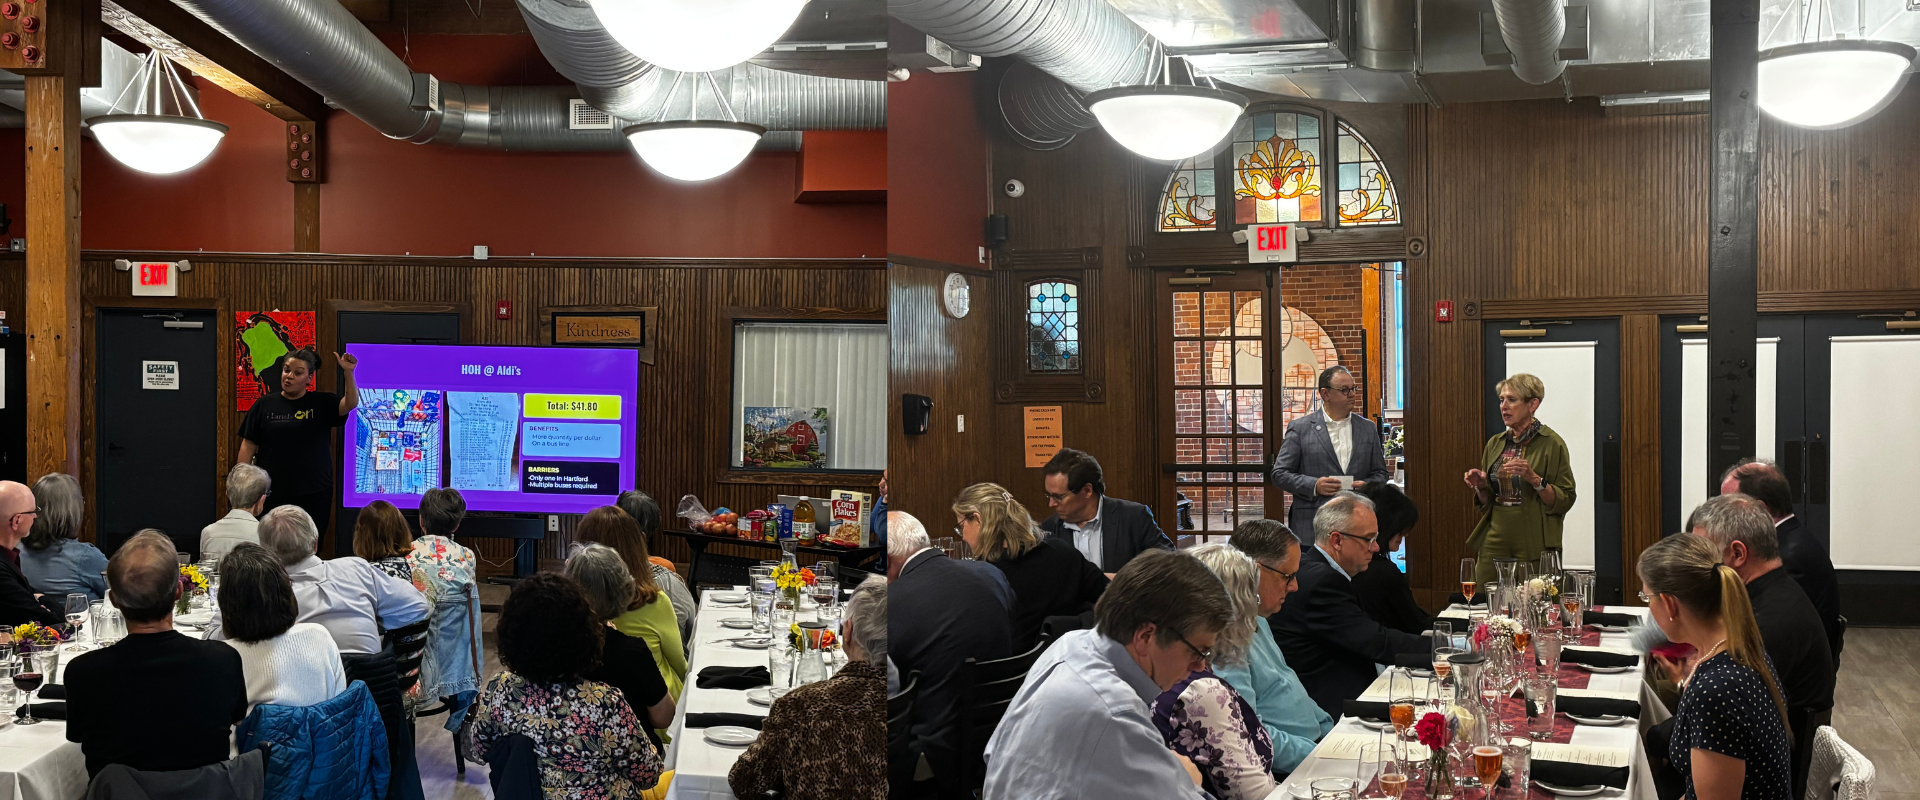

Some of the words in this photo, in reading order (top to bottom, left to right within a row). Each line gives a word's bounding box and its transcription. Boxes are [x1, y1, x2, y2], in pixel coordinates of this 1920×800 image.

[1257, 226, 1288, 251] EXIT
[140, 263, 169, 286] EXIT
[566, 322, 631, 337] Kindness
[461, 364, 481, 375] HOH
[483, 364, 495, 377] @
[496, 365, 521, 376] Aldi's
[547, 401, 569, 410] Total:
[571, 401, 598, 411] $41.80
[528, 466, 560, 474] BARRIERS
[836, 500, 855, 510] Corn
[834, 508, 857, 517] Flakes
